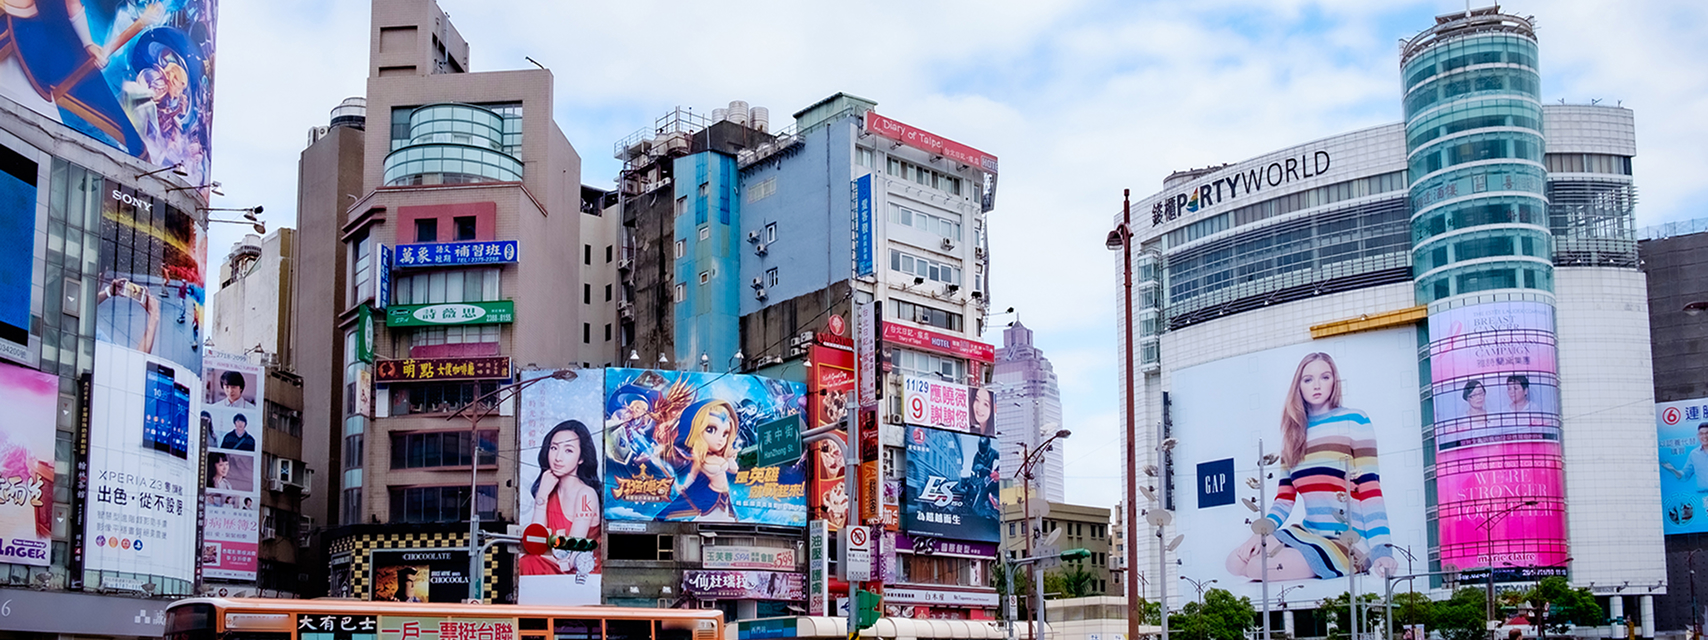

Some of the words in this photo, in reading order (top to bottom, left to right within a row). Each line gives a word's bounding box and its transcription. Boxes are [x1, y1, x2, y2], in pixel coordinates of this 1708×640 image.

[882, 119, 905, 136] Diary
[908, 131, 916, 140] of
[919, 133, 943, 148] Taipei
[112, 189, 153, 213] SONY
[454, 244, 502, 257] 補習班
[1473, 323, 1520, 333] CANCER
[1474, 316, 1517, 327] BREAST
[931, 337, 951, 349] HOTEL
[403, 358, 435, 378] 萌點
[930, 405, 969, 430] 謝謝您
[99, 470, 147, 488] XPERIA
[149, 478, 163, 491] Z3
[1204, 473, 1226, 495] GAP
[1457, 484, 1548, 500] STRONGER
[1454, 501, 1554, 521] TOGETHER
[734, 552, 750, 561] SPA
[1477, 553, 1507, 564] marie
[1508, 551, 1536, 562] claire
[1, 598, 12, 617] 6
[298, 613, 377, 632] 大有巴士
[381, 620, 514, 640] 一戶一票挺台聯
